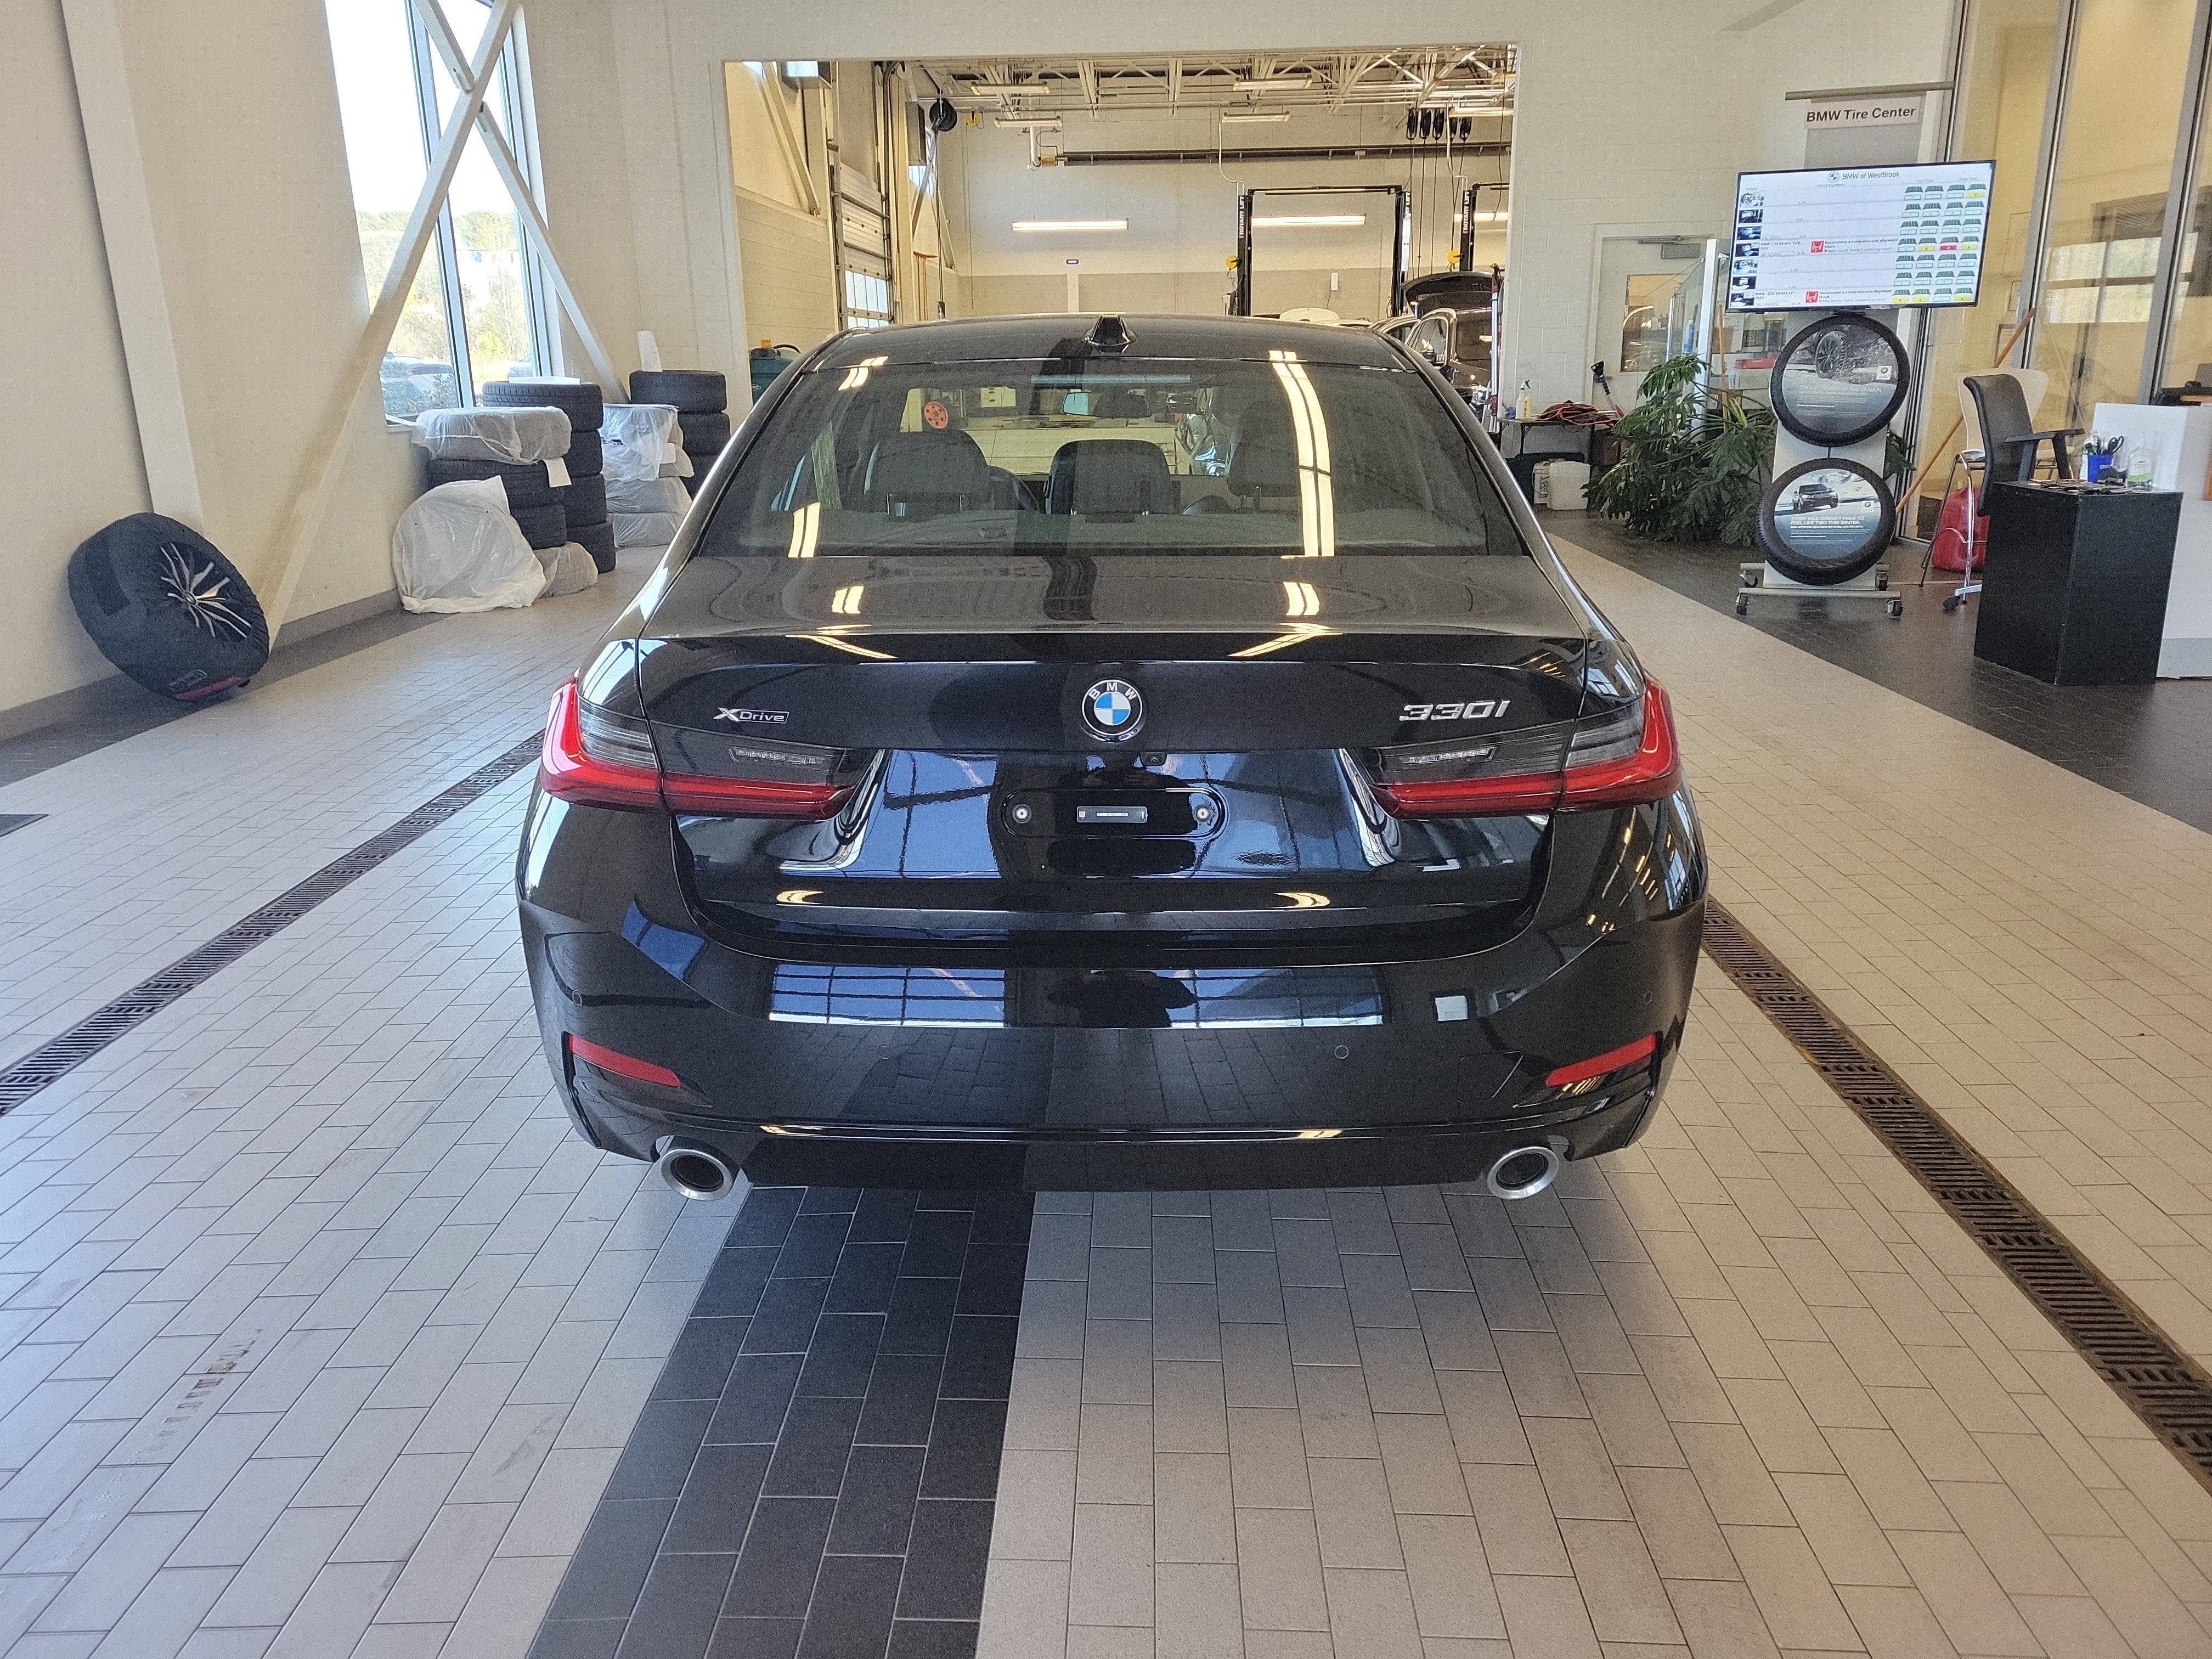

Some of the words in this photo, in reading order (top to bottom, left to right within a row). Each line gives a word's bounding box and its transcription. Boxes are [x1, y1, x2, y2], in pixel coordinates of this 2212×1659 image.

[1807, 110, 1841, 122] BMW
[1844, 109, 1868, 120] Tire
[1872, 107, 1916, 119] Center
[1088, 682, 1137, 701] BMW
